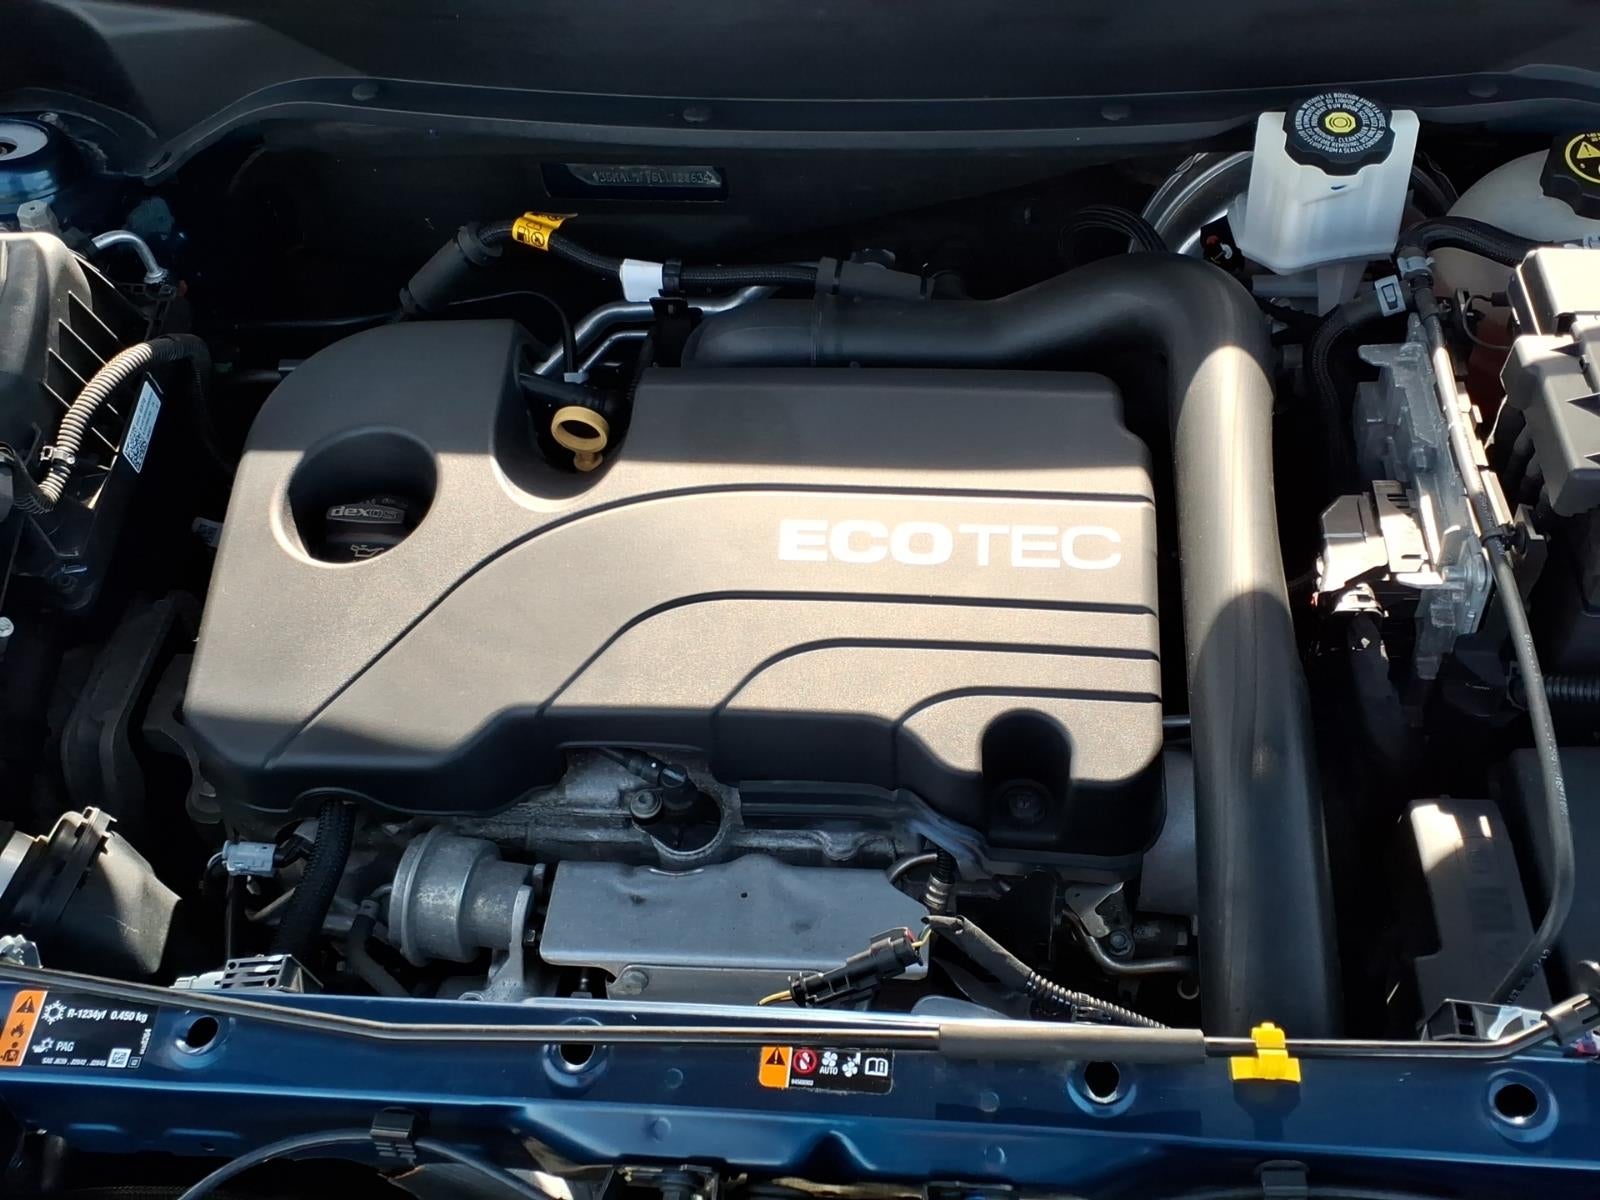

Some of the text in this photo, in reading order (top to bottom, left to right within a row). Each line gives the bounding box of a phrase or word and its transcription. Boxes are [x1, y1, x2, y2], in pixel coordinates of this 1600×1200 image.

[1338, 135, 1356, 143] CLEAN
[1322, 145, 1338, 153] FROM
[777, 518, 1122, 571] ECOTEC
[66, 1008, 149, 1024] R-1234yf 0.450 kg
[55, 1041, 75, 1052] PAG
[819, 1066, 838, 1075] AUTO
